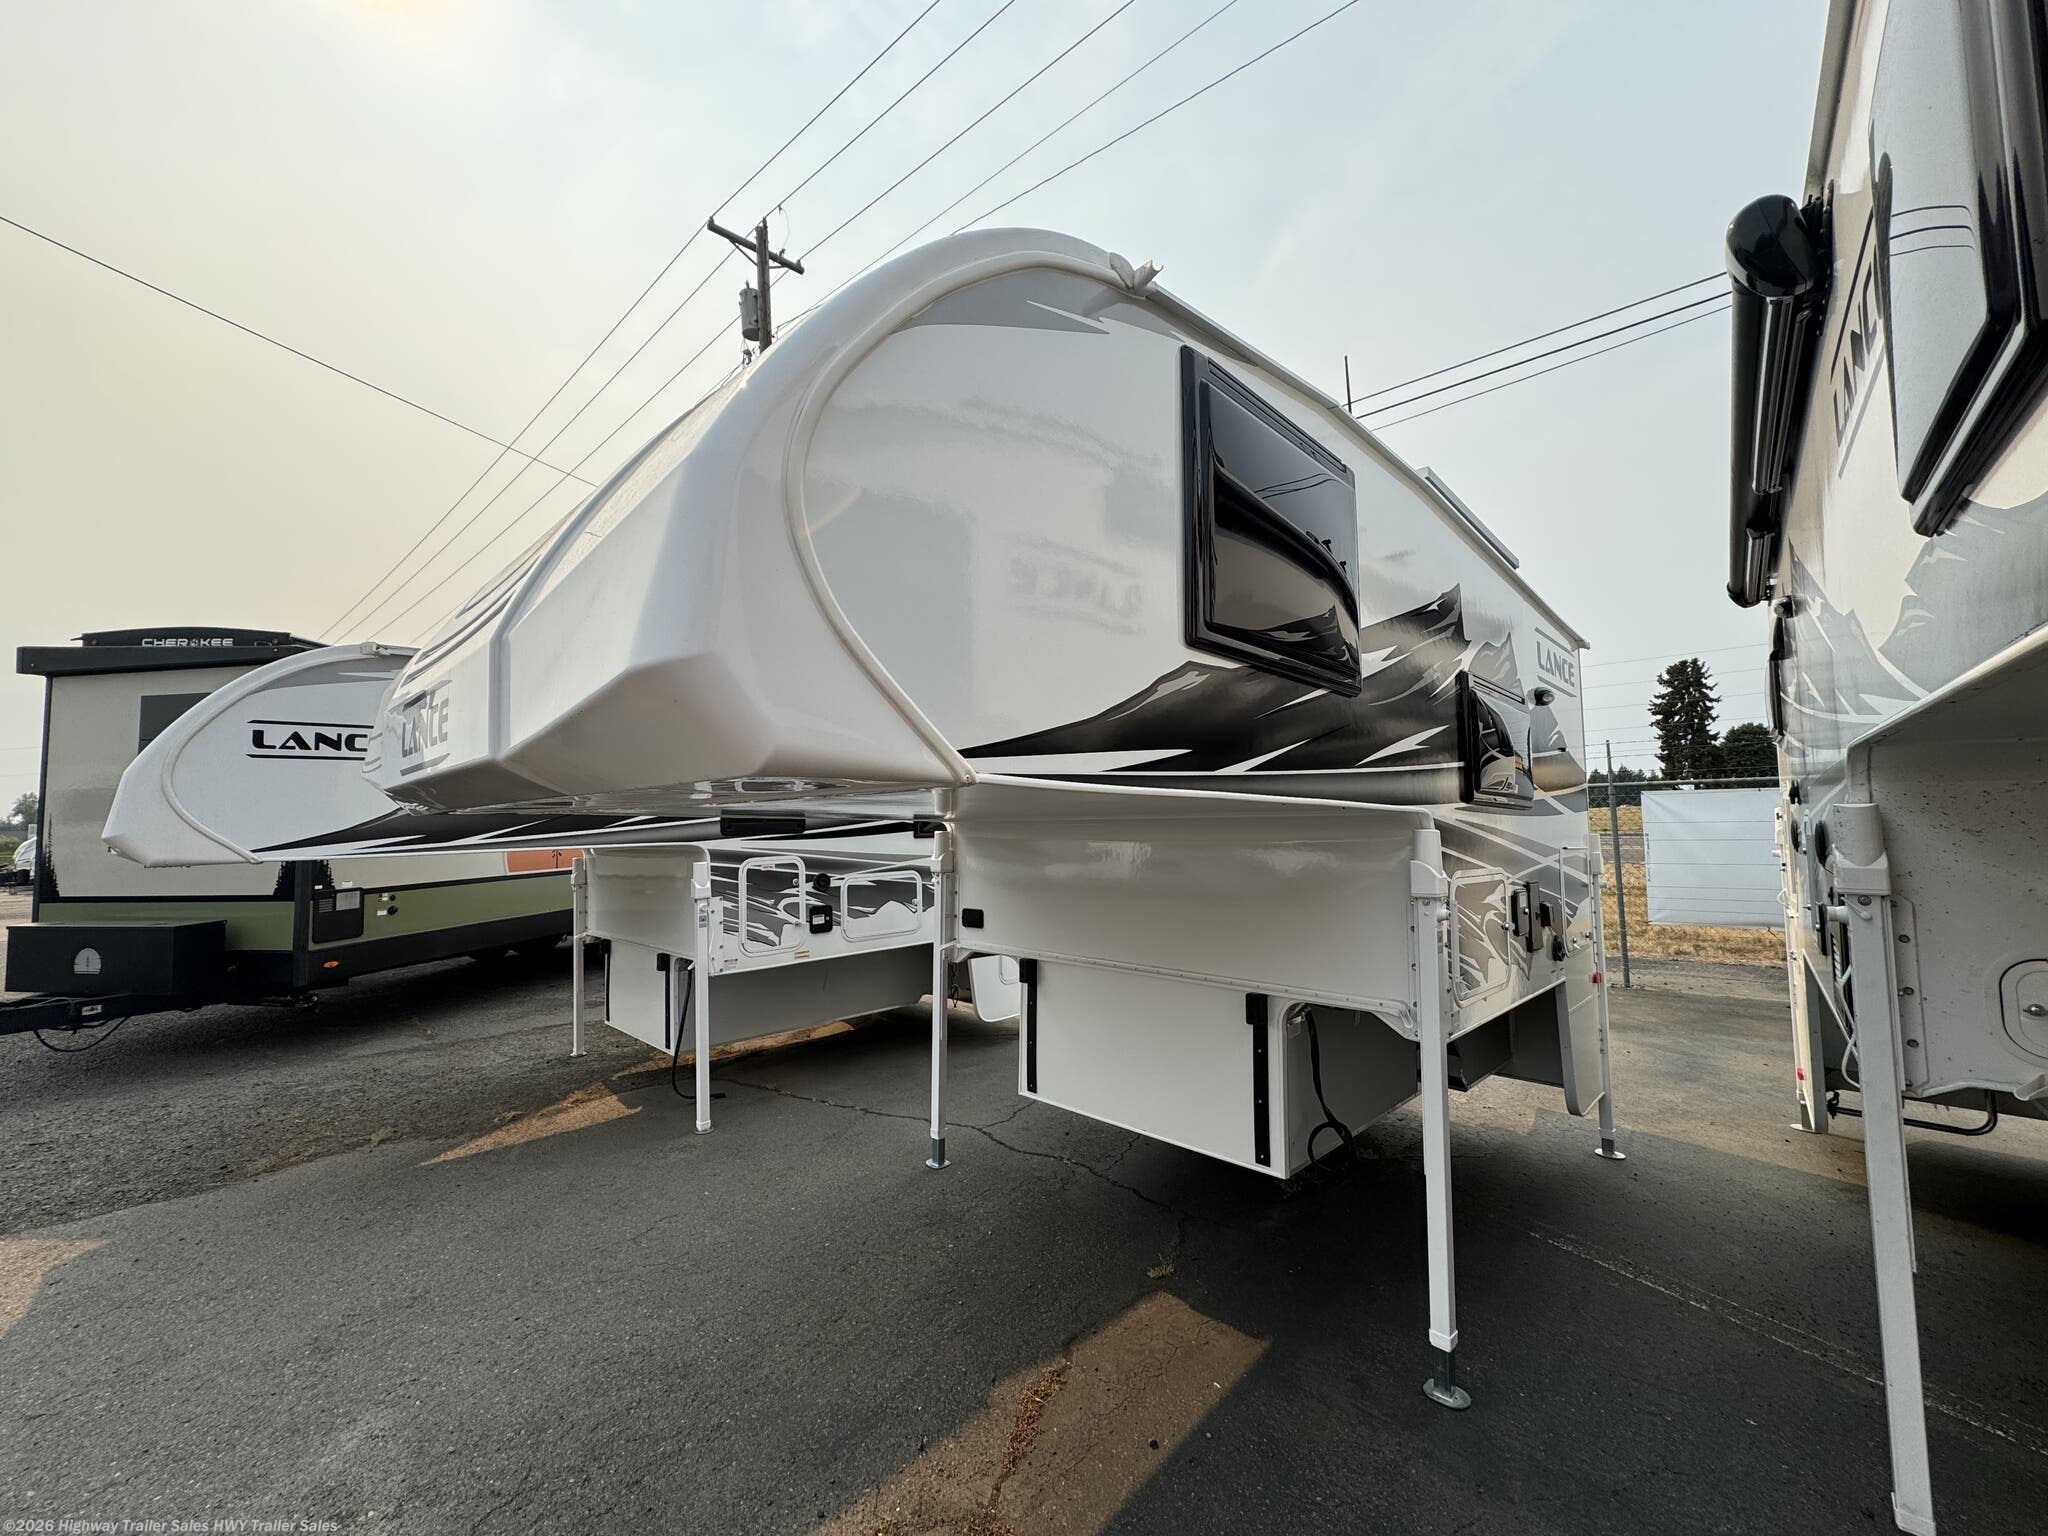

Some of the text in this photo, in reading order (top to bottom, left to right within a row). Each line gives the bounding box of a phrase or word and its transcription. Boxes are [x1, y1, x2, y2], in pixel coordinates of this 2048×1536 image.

[141, 638, 234, 648] CHEROKEE
[1536, 640, 1576, 688] LANCE
[252, 729, 368, 752] LANC
[401, 697, 449, 759] LANCE
